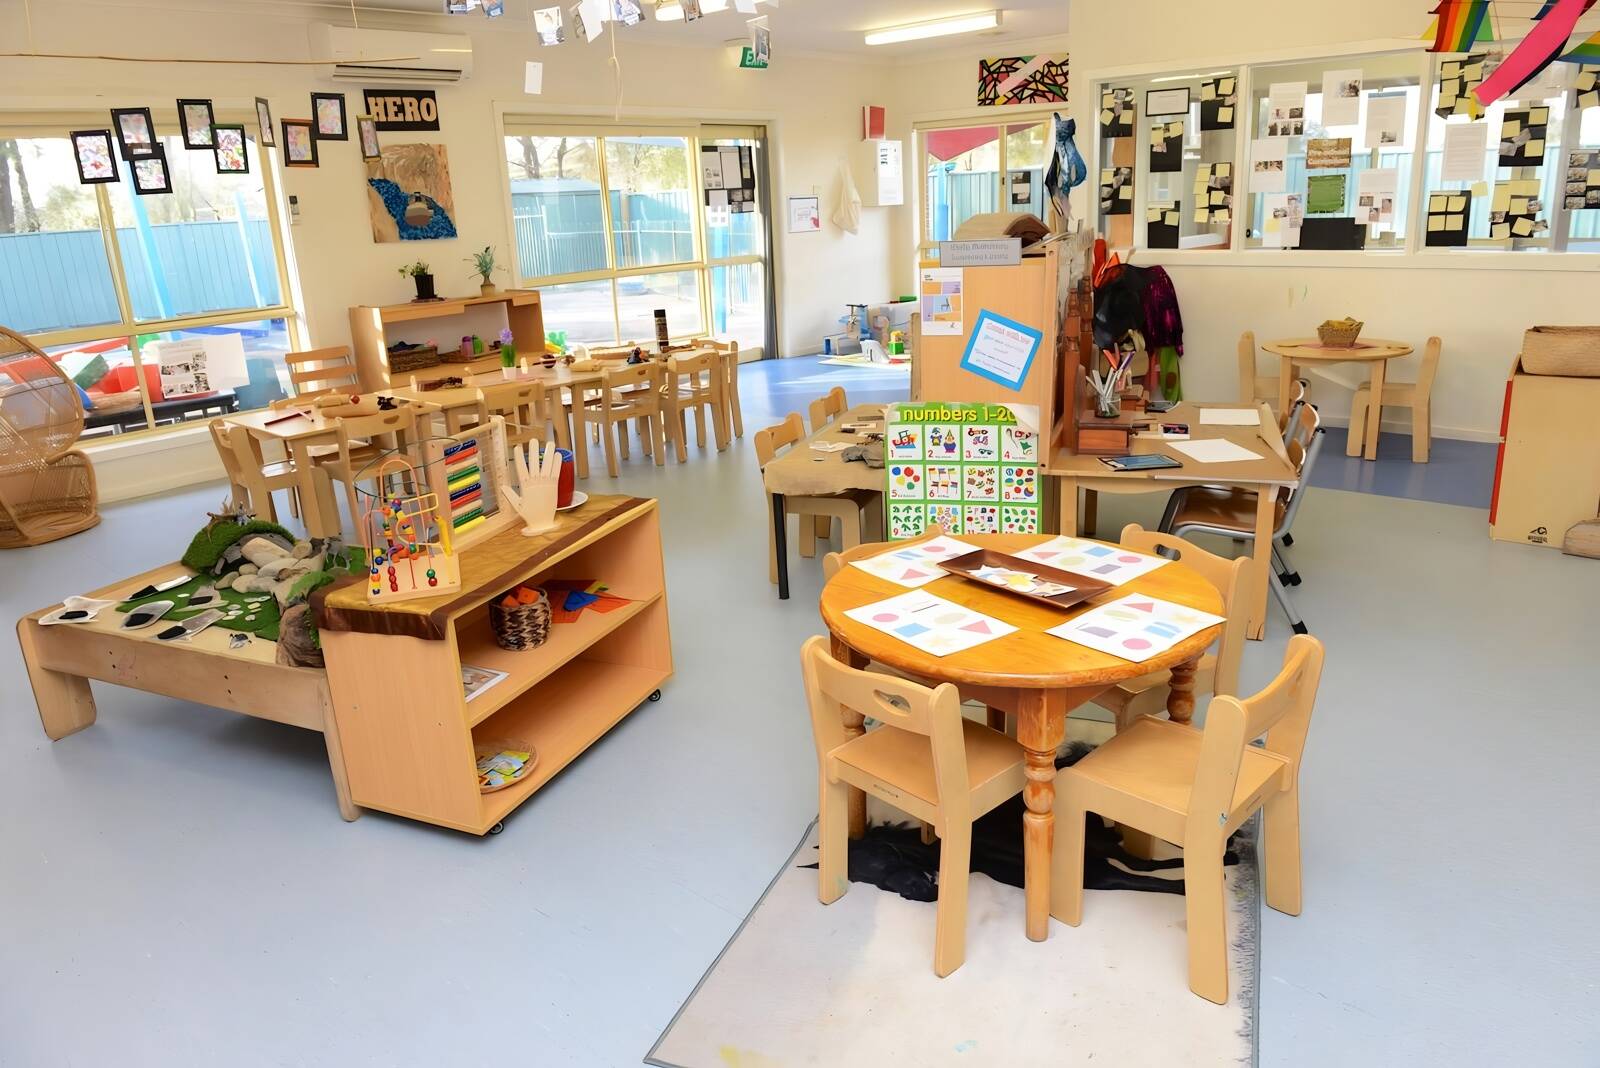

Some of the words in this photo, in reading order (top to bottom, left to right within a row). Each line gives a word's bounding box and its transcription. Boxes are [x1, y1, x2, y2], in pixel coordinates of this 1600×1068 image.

[367, 96, 437, 122] HERO
[903, 405, 977, 422] numbers
[890, 449, 894, 458] 1
[927, 449, 934, 458] 2
[965, 450, 972, 458] 3
[1003, 450, 1010, 459] 4
[891, 489, 898, 497] 5
[928, 489, 935, 498] 6
[966, 490, 972, 499] 7
[1004, 491, 1011, 499] 8
[893, 528, 899, 536] 9
